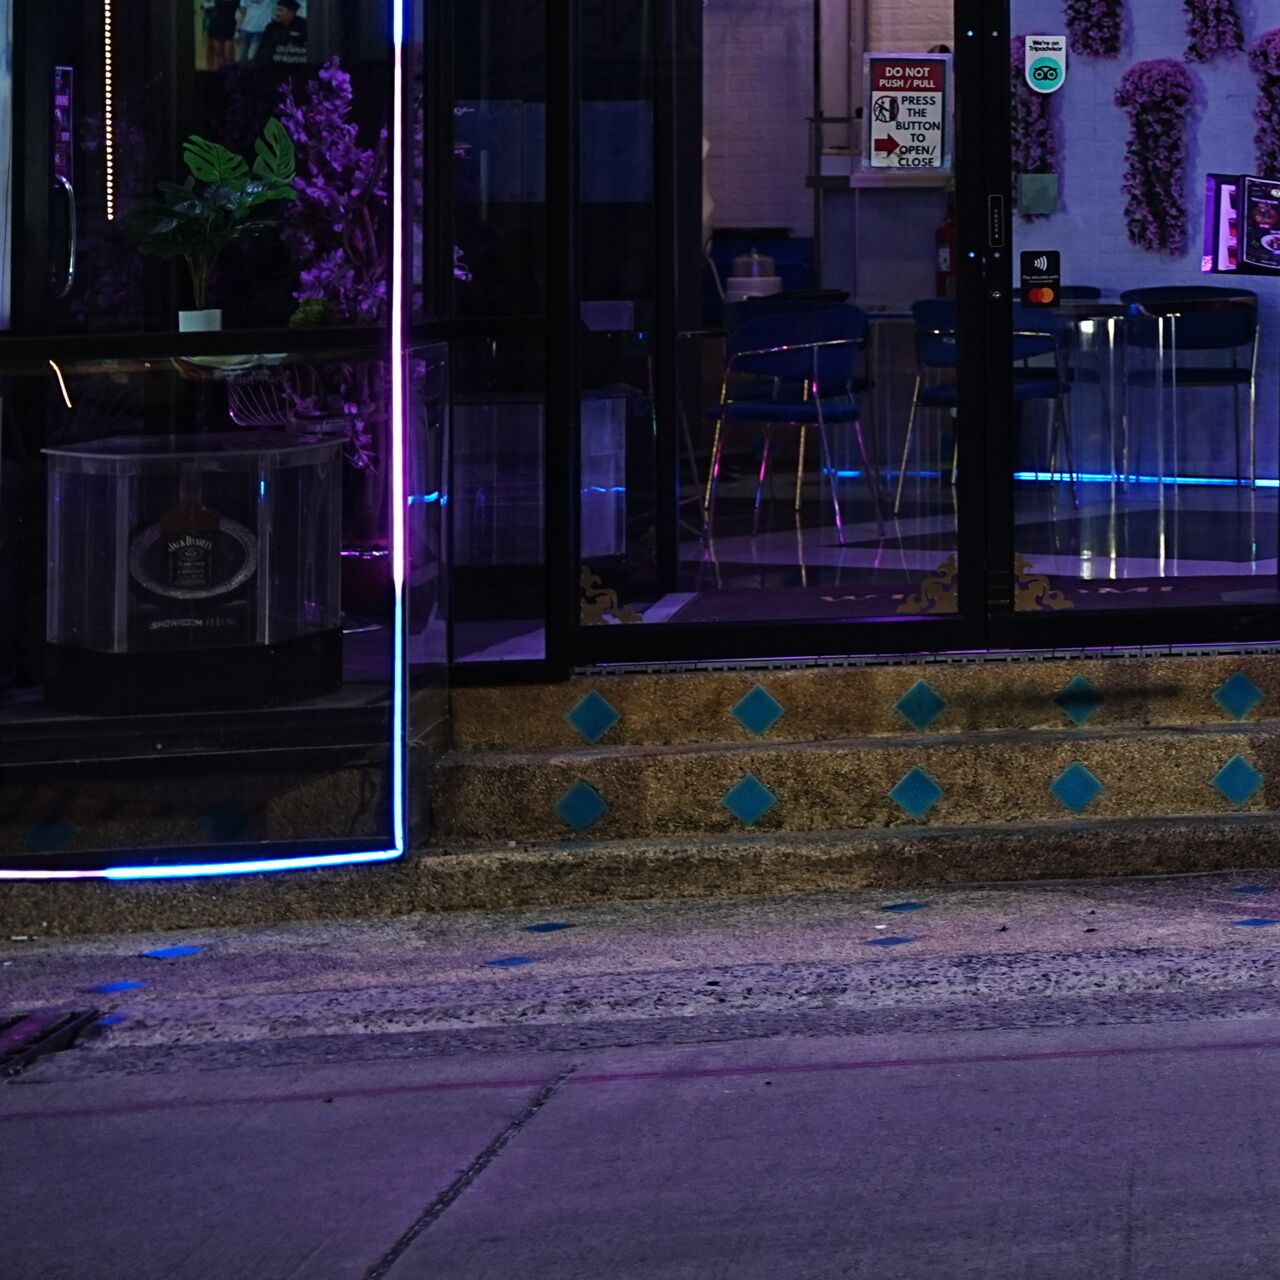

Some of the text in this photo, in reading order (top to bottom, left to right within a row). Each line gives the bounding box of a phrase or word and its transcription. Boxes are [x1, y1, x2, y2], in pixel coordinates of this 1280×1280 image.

[885, 67, 930, 77] DO NOT
[879, 79, 904, 88] PUSH
[913, 79, 936, 88] PULL
[901, 95, 936, 106] PRESS
[906, 107, 927, 118] THE
[895, 121, 941, 131] BUTTON
[910, 133, 926, 143] TO
[898, 157, 935, 167] CLOSE
